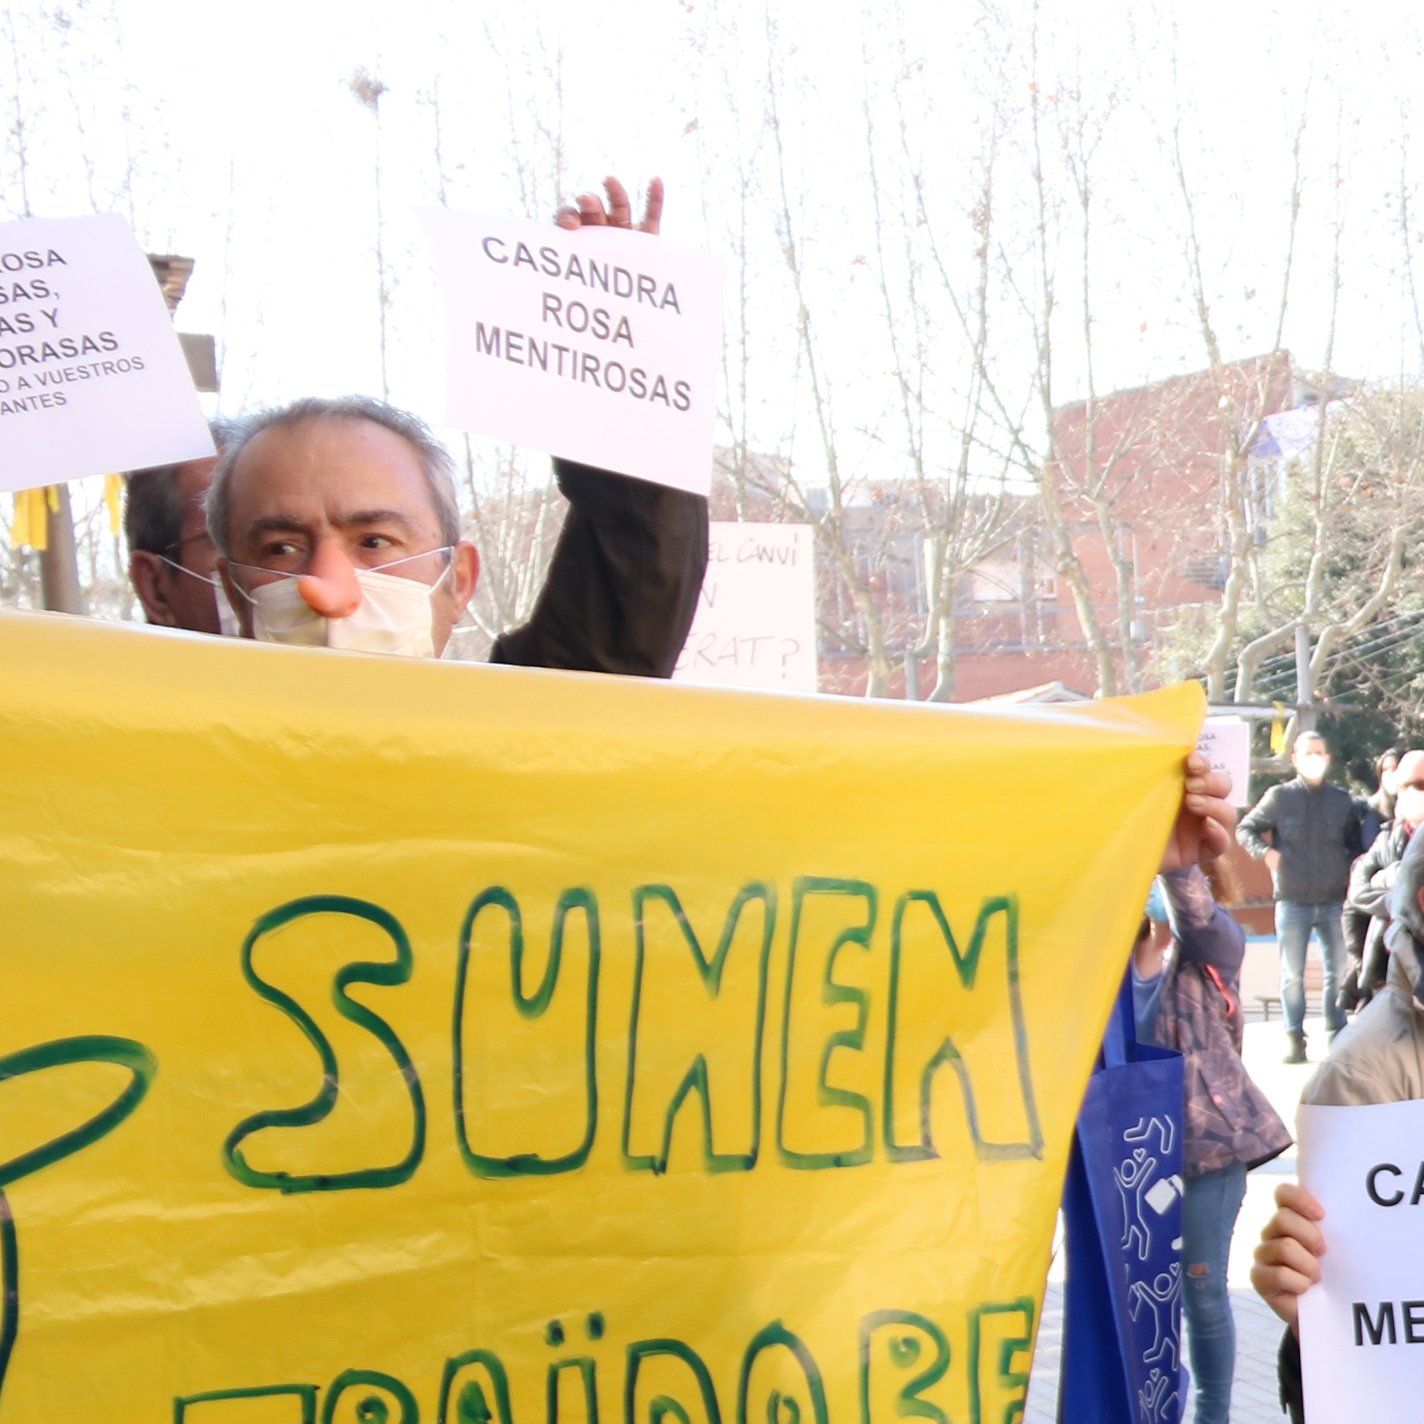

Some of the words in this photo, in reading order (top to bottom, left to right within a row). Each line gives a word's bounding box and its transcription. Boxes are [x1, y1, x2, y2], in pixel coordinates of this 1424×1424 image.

[481, 236, 681, 315] CASANDRA
[40, 307, 60, 328] Y
[542, 291, 635, 348] ROSA
[17, 376, 32, 391] A
[34, 356, 145, 387] VUESTROS
[475, 320, 692, 412] MENTIROSAS
